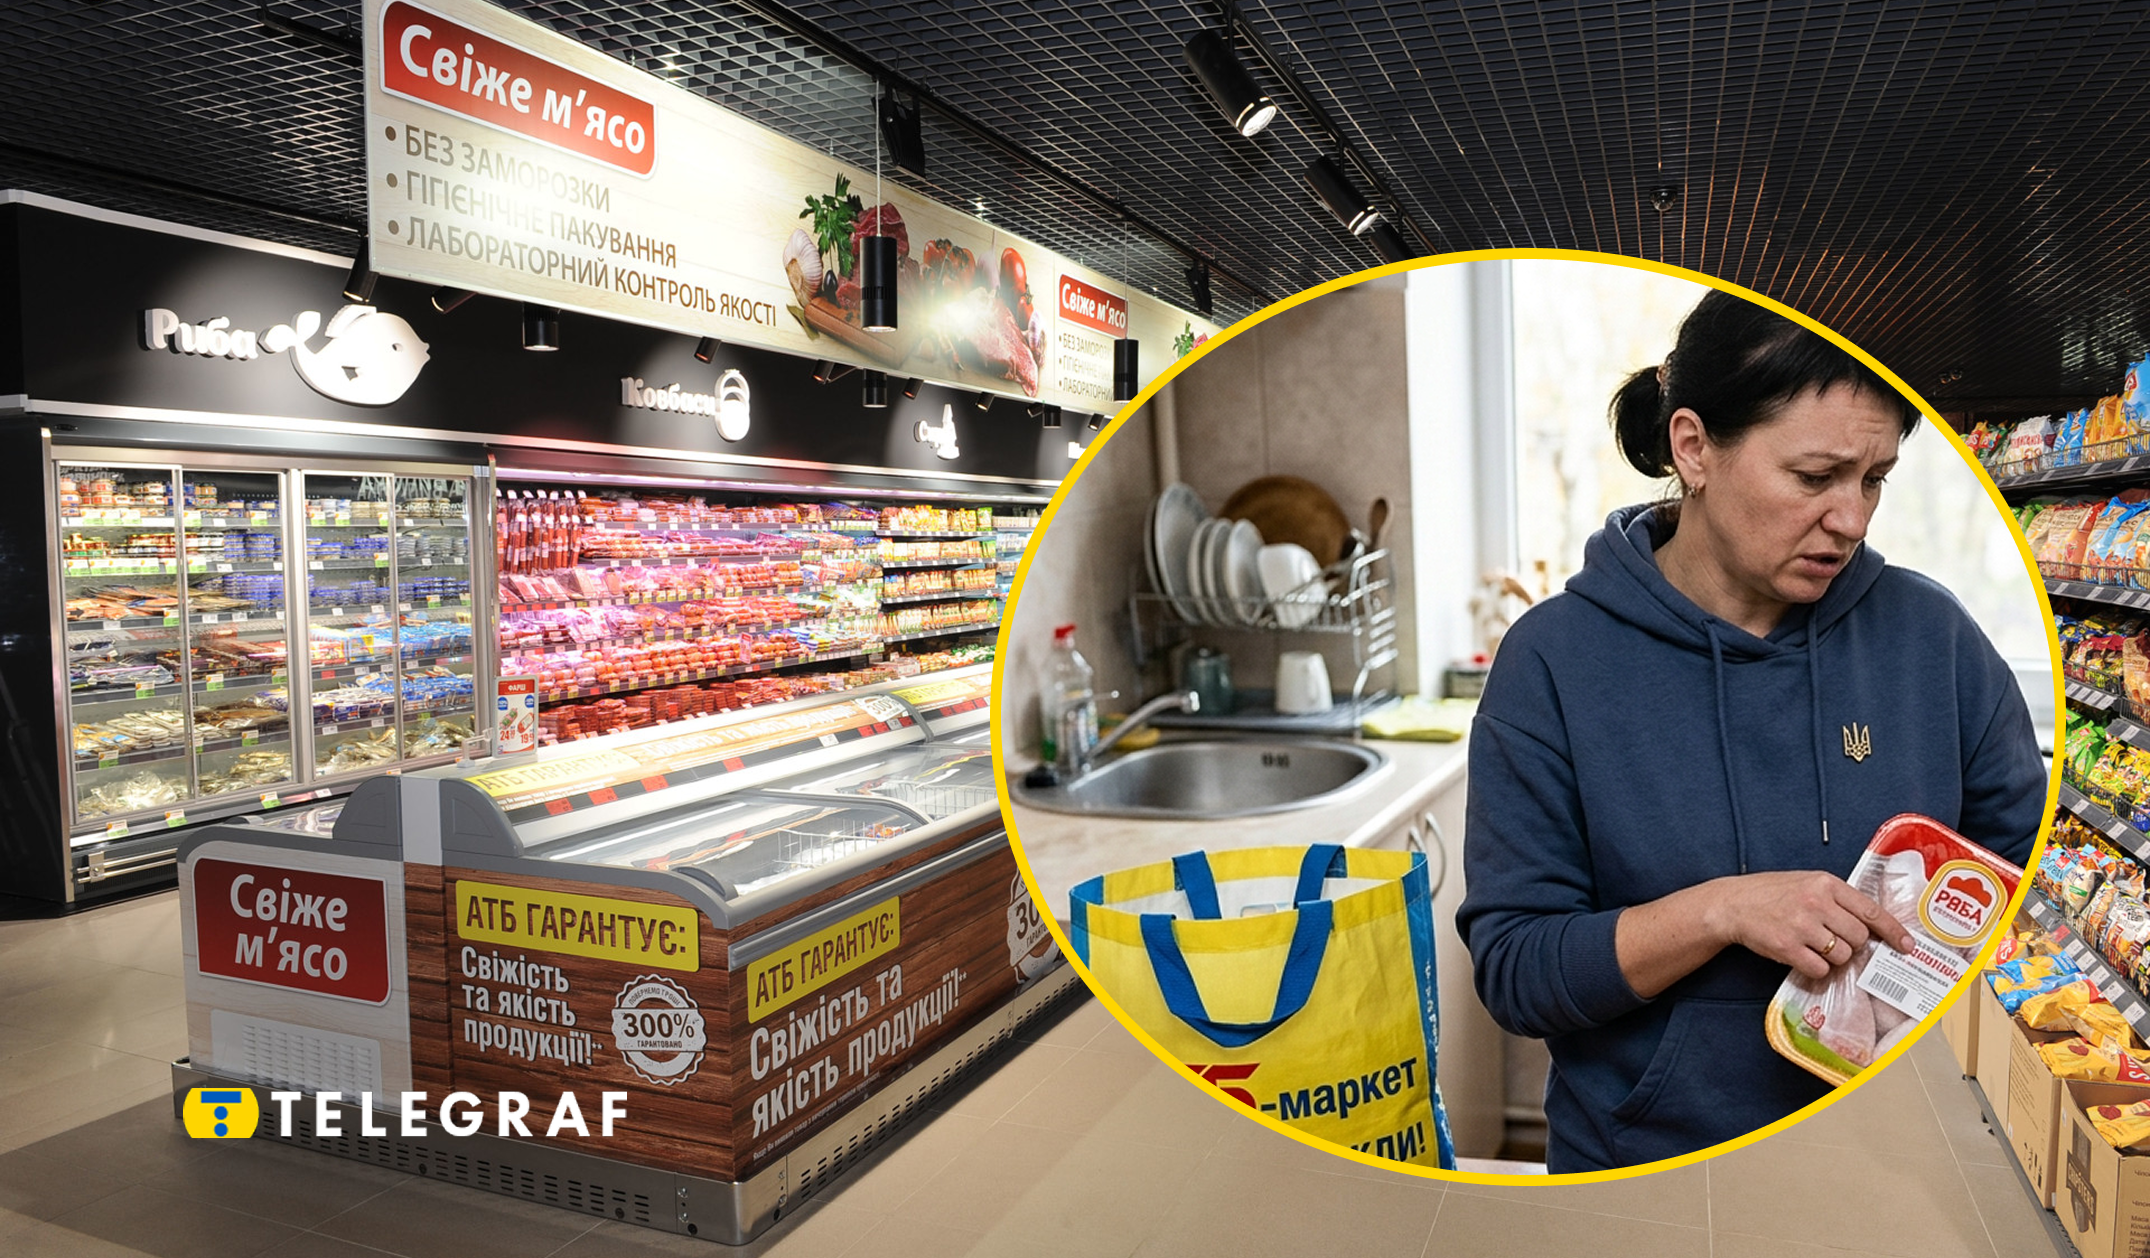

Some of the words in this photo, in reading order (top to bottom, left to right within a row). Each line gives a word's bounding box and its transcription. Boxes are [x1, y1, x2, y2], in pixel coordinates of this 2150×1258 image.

[400, 23, 533, 114] Свіже
[541, 88, 646, 155] м'ясо
[405, 124, 455, 167] БЕЗ
[461, 141, 610, 214] ЗАМОРОЗКИ
[406, 168, 544, 236] ГІГІЄНІЧНЕ
[550, 211, 677, 269] ПАКУВАННЯ
[407, 215, 610, 290] ЛАБОРАТОРНИЙ
[614, 268, 716, 314] КОНТРОЛЬ
[719, 293, 777, 328] ЯКОСТІ
[1061, 282, 1095, 319] Свіже
[145, 308, 259, 360] Риба
[508, 684, 526, 692] ФАРШ
[230, 873, 349, 932] Свіже
[466, 895, 518, 933] АТБ
[526, 902, 687, 956] ГАРАНТУЄ:
[235, 925, 349, 981] м'ясо
[460, 945, 571, 993] Свіжість
[755, 959, 795, 1008] АТБ
[800, 912, 895, 984] ГАРАНТУЄ:
[461, 984, 491, 1013] та
[497, 990, 577, 1028] якість
[628, 986, 660, 1006] ПОВЕРНЕМО
[750, 986, 869, 1081] Свіжість
[876, 964, 903, 1007] та
[622, 1012, 695, 1039] 300%
[637, 1040, 683, 1049] ГАРАНТОВАНО
[752, 1056, 840, 1140] якість
